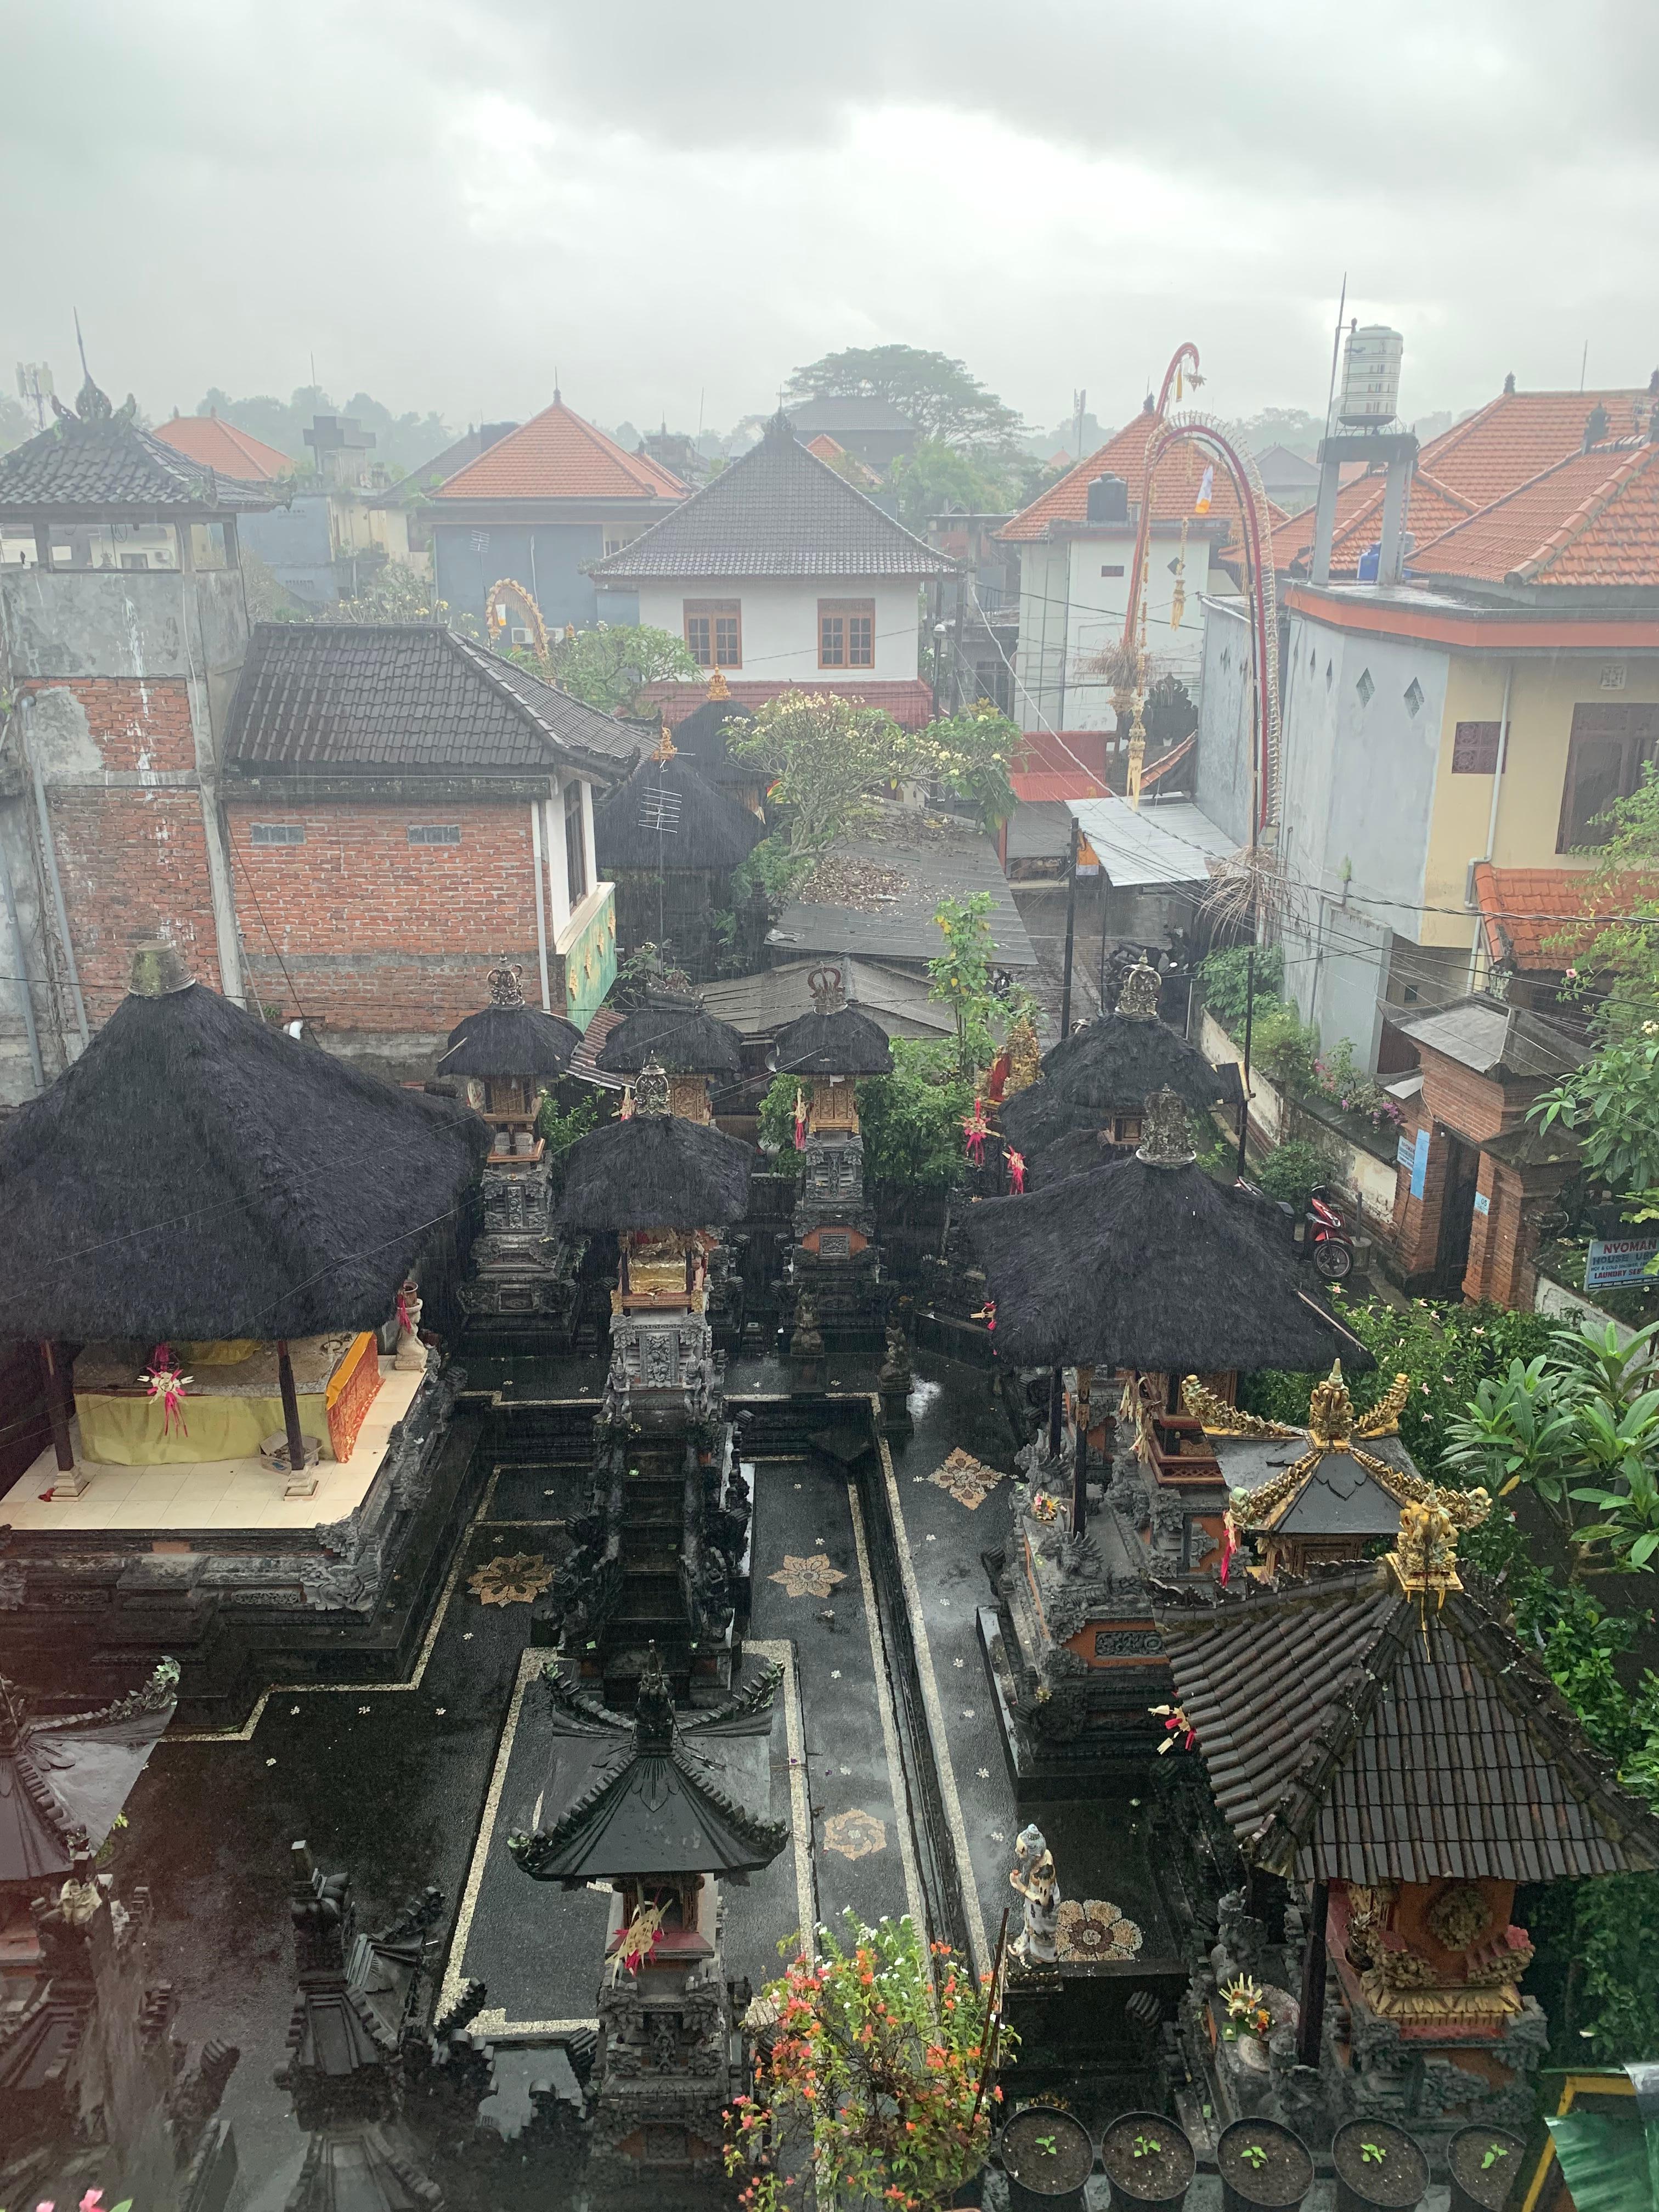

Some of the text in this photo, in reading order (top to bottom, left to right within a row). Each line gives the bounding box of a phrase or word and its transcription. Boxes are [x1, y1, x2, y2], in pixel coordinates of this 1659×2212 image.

[1481, 1198, 1487, 1206] 05
[1603, 1239, 1657, 1254] NYOMAN
[1593, 1255, 1629, 1266] HOUSE
[1594, 1269, 1627, 1279] LAUNDRY
